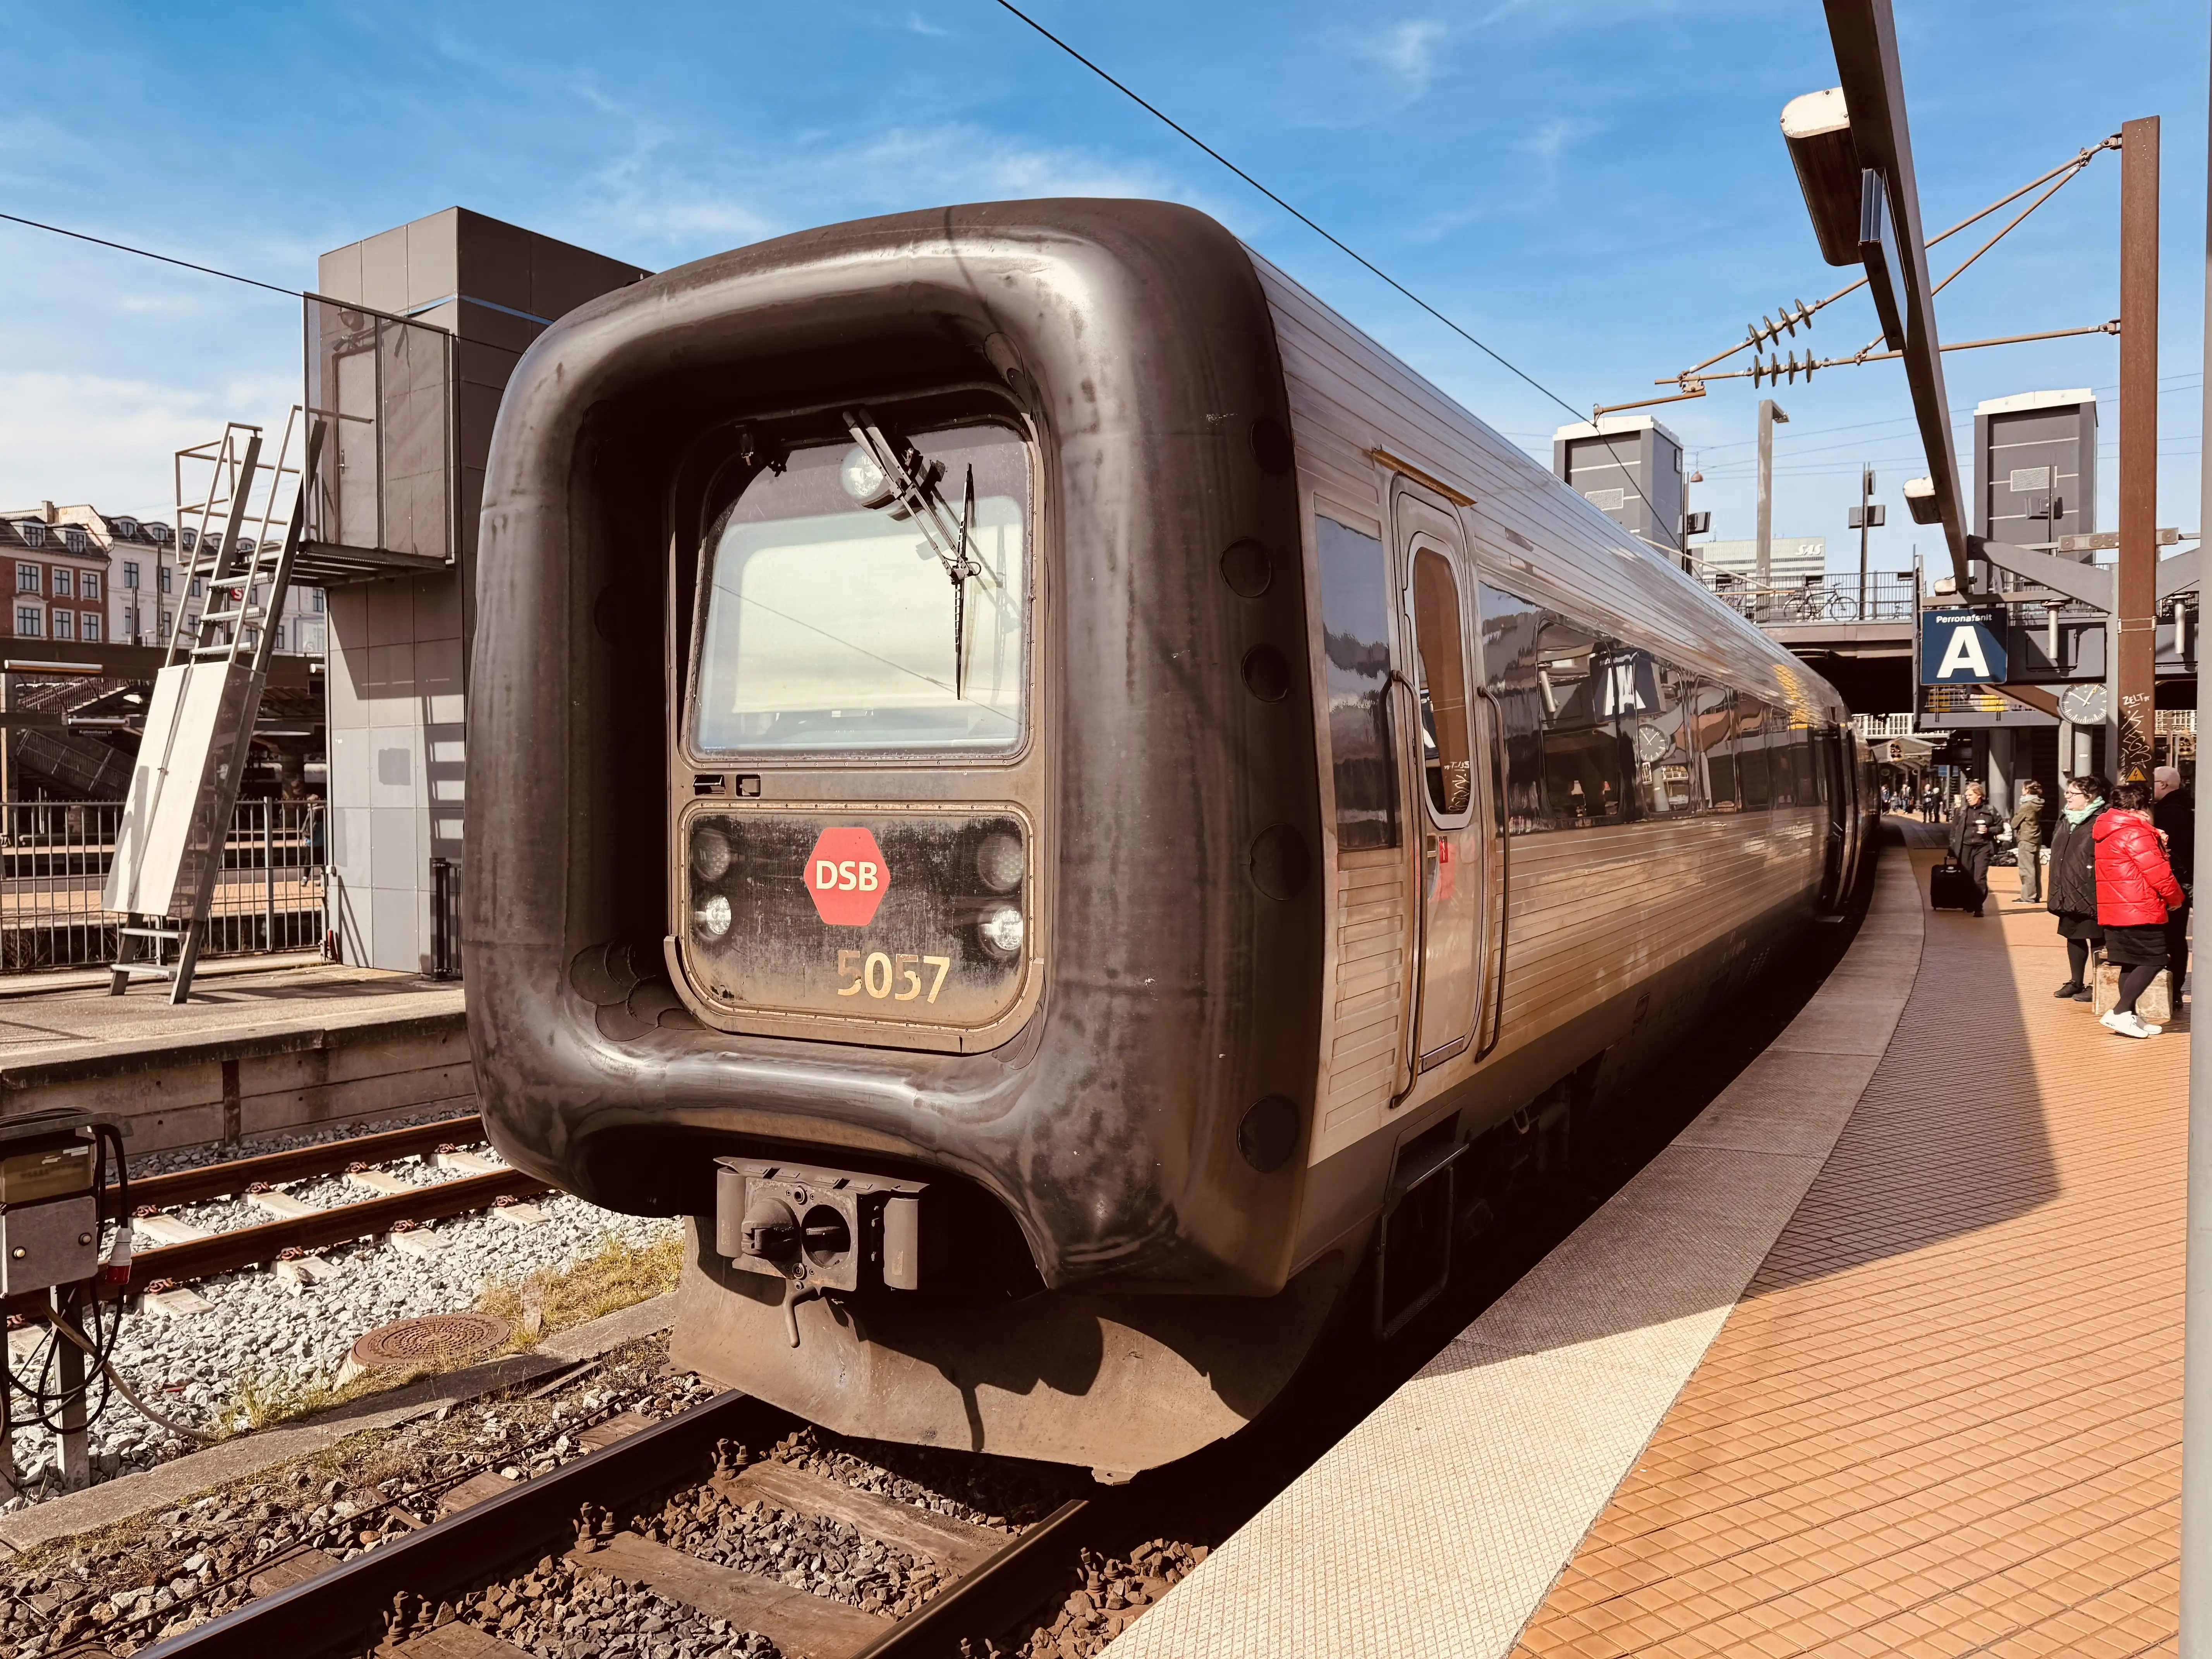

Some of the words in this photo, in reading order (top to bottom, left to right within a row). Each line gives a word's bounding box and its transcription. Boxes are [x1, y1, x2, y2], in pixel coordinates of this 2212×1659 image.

[1794, 544, 1823, 555] SAS
[234, 588, 242, 599] S
[1936, 613, 1992, 623] Perronafsnit
[1937, 626, 1990, 678] A
[816, 860, 878, 891] DSB
[837, 950, 950, 1004] 5057
